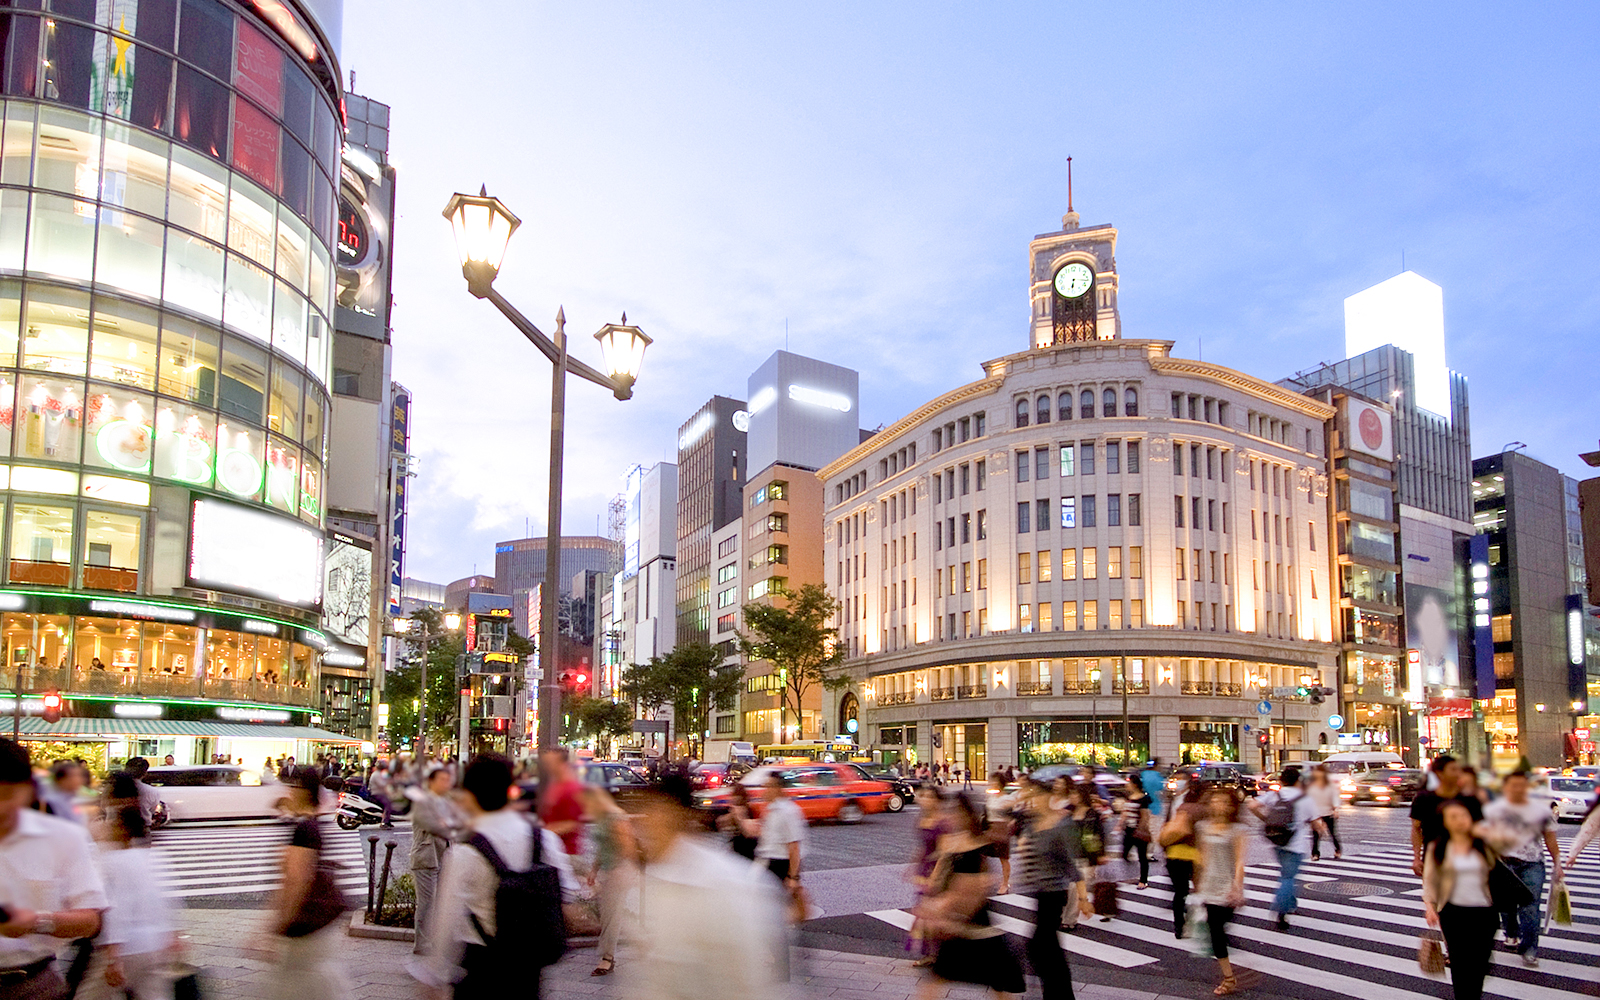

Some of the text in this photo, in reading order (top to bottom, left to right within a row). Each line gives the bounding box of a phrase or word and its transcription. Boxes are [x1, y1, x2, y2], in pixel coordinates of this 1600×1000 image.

[238, 40, 266, 63] ONE
[679, 411, 711, 451] GUCCI
[334, 532, 353, 544] RICOH
[14, 567, 66, 581] SALON
[148, 605, 194, 620] DOUTOR
